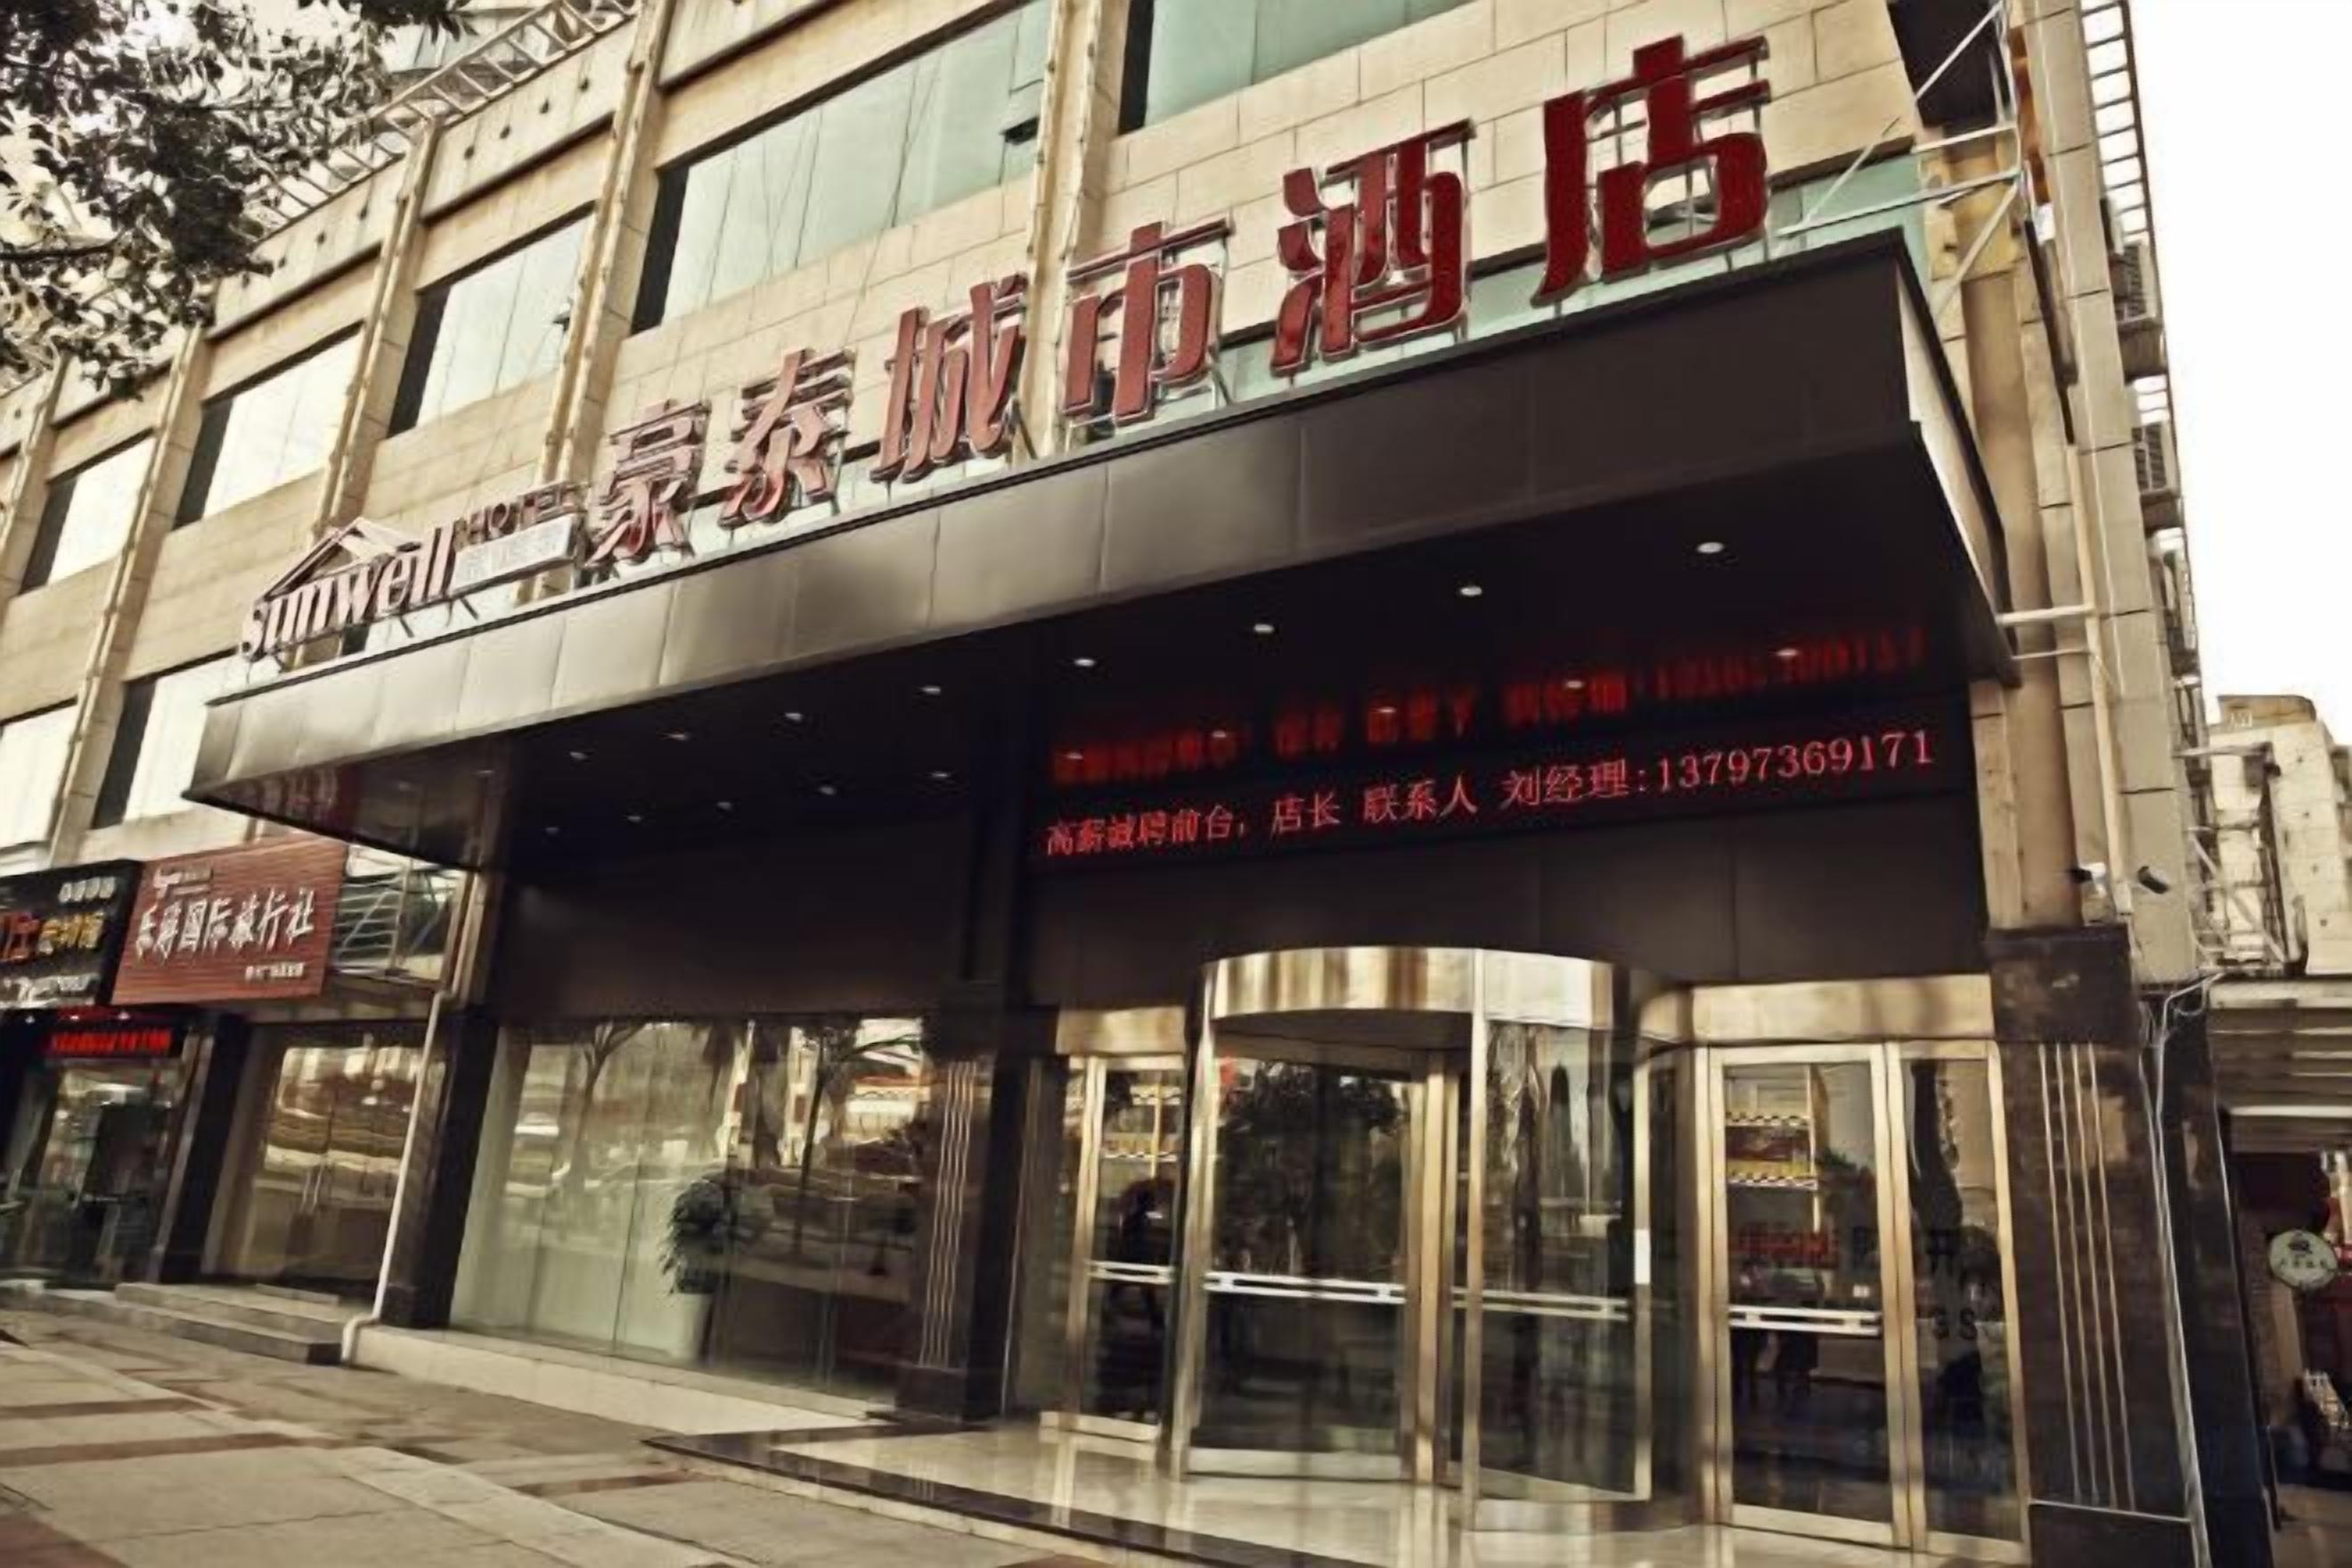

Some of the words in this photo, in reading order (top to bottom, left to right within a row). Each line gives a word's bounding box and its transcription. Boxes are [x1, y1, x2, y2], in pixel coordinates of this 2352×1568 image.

[592, 34, 1771, 567] 豪泰城市酒店
[1270, 791, 1342, 838] 店长
[1361, 775, 1479, 823] 联系人
